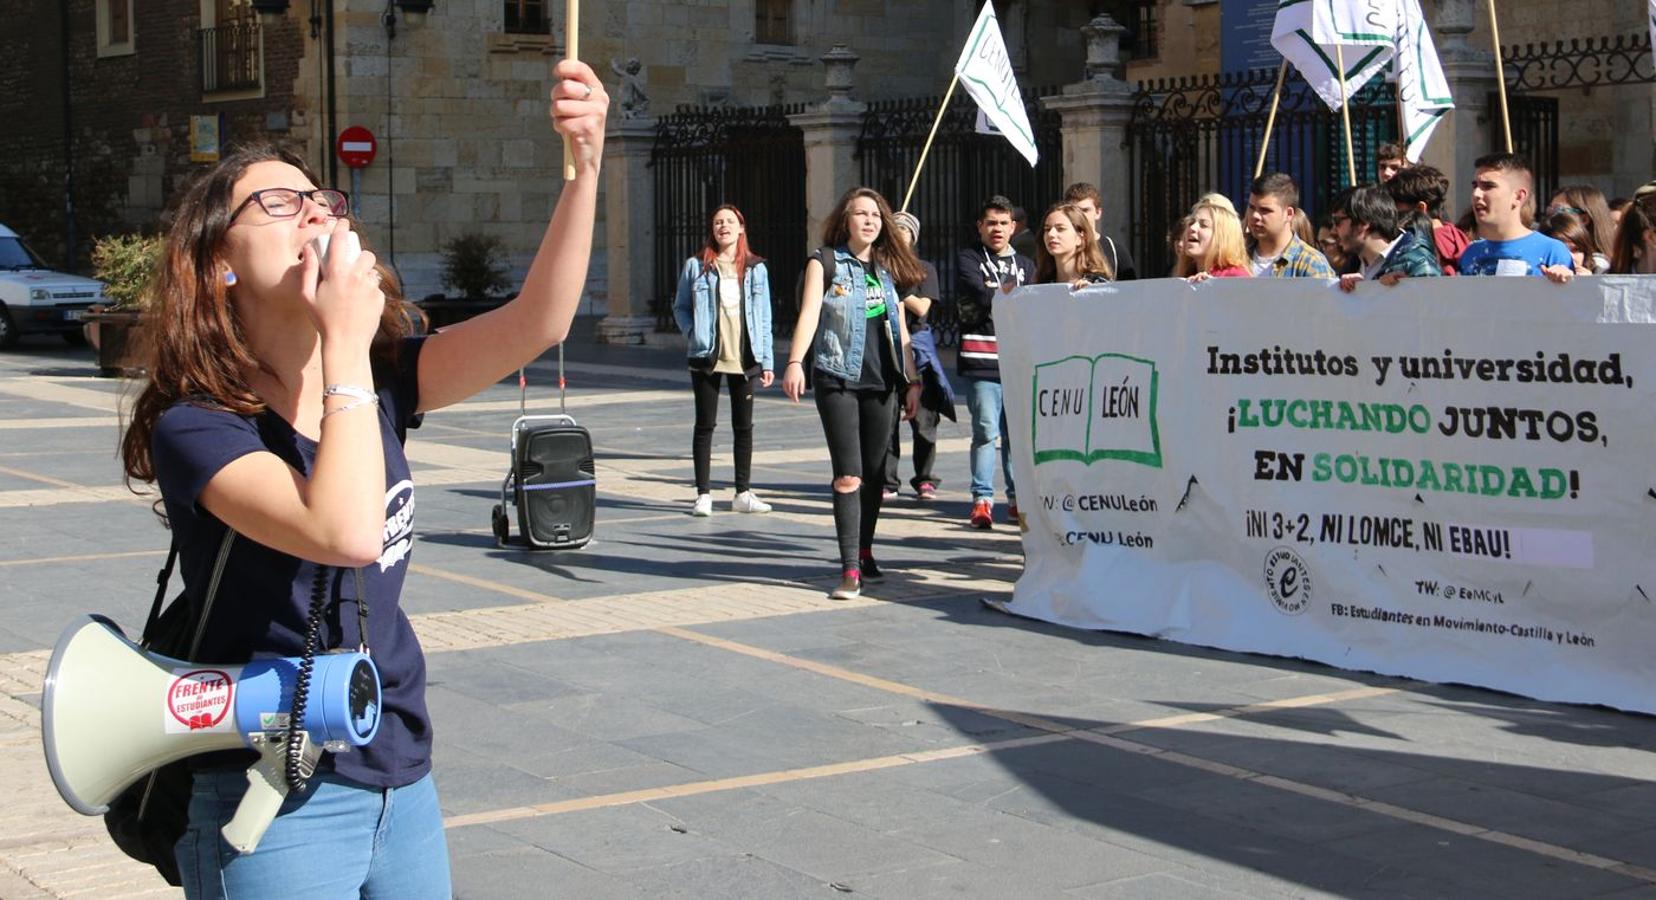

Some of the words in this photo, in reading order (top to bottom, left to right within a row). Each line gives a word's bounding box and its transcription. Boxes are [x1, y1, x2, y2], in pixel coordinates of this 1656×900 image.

[1207, 346, 1358, 376] Institutos
[1373, 355, 1392, 386] y
[1399, 349, 1633, 389] universidad,
[1038, 389, 1083, 417] CENU
[1102, 376, 1139, 418] LEÓN
[1228, 399, 1431, 435] ¡LUCHANDO
[1438, 407, 1607, 448] JUNTOS,
[1254, 450, 1304, 482] EN
[1312, 452, 1580, 499] SOLIDARIDAD!
[1118, 531, 1153, 548] León
[1246, 509, 1268, 538] ¡NI
[1272, 512, 1315, 546] 3+2,
[1319, 514, 1342, 543] NI
[1348, 515, 1420, 552] LOMCE,
[1423, 522, 1443, 551] NI
[1449, 525, 1511, 559] EBAU!
[1415, 581, 1440, 597] TW:
[1331, 603, 1348, 616] FB:
[1350, 605, 1413, 625] Estudiantes
[1416, 616, 1431, 627] en
[1433, 615, 1553, 641] Movimiento-Castilla
[1555, 632, 1563, 644] y
[176, 678, 223, 698] FRENTE
[177, 696, 225, 712] ESTUDIANTES
